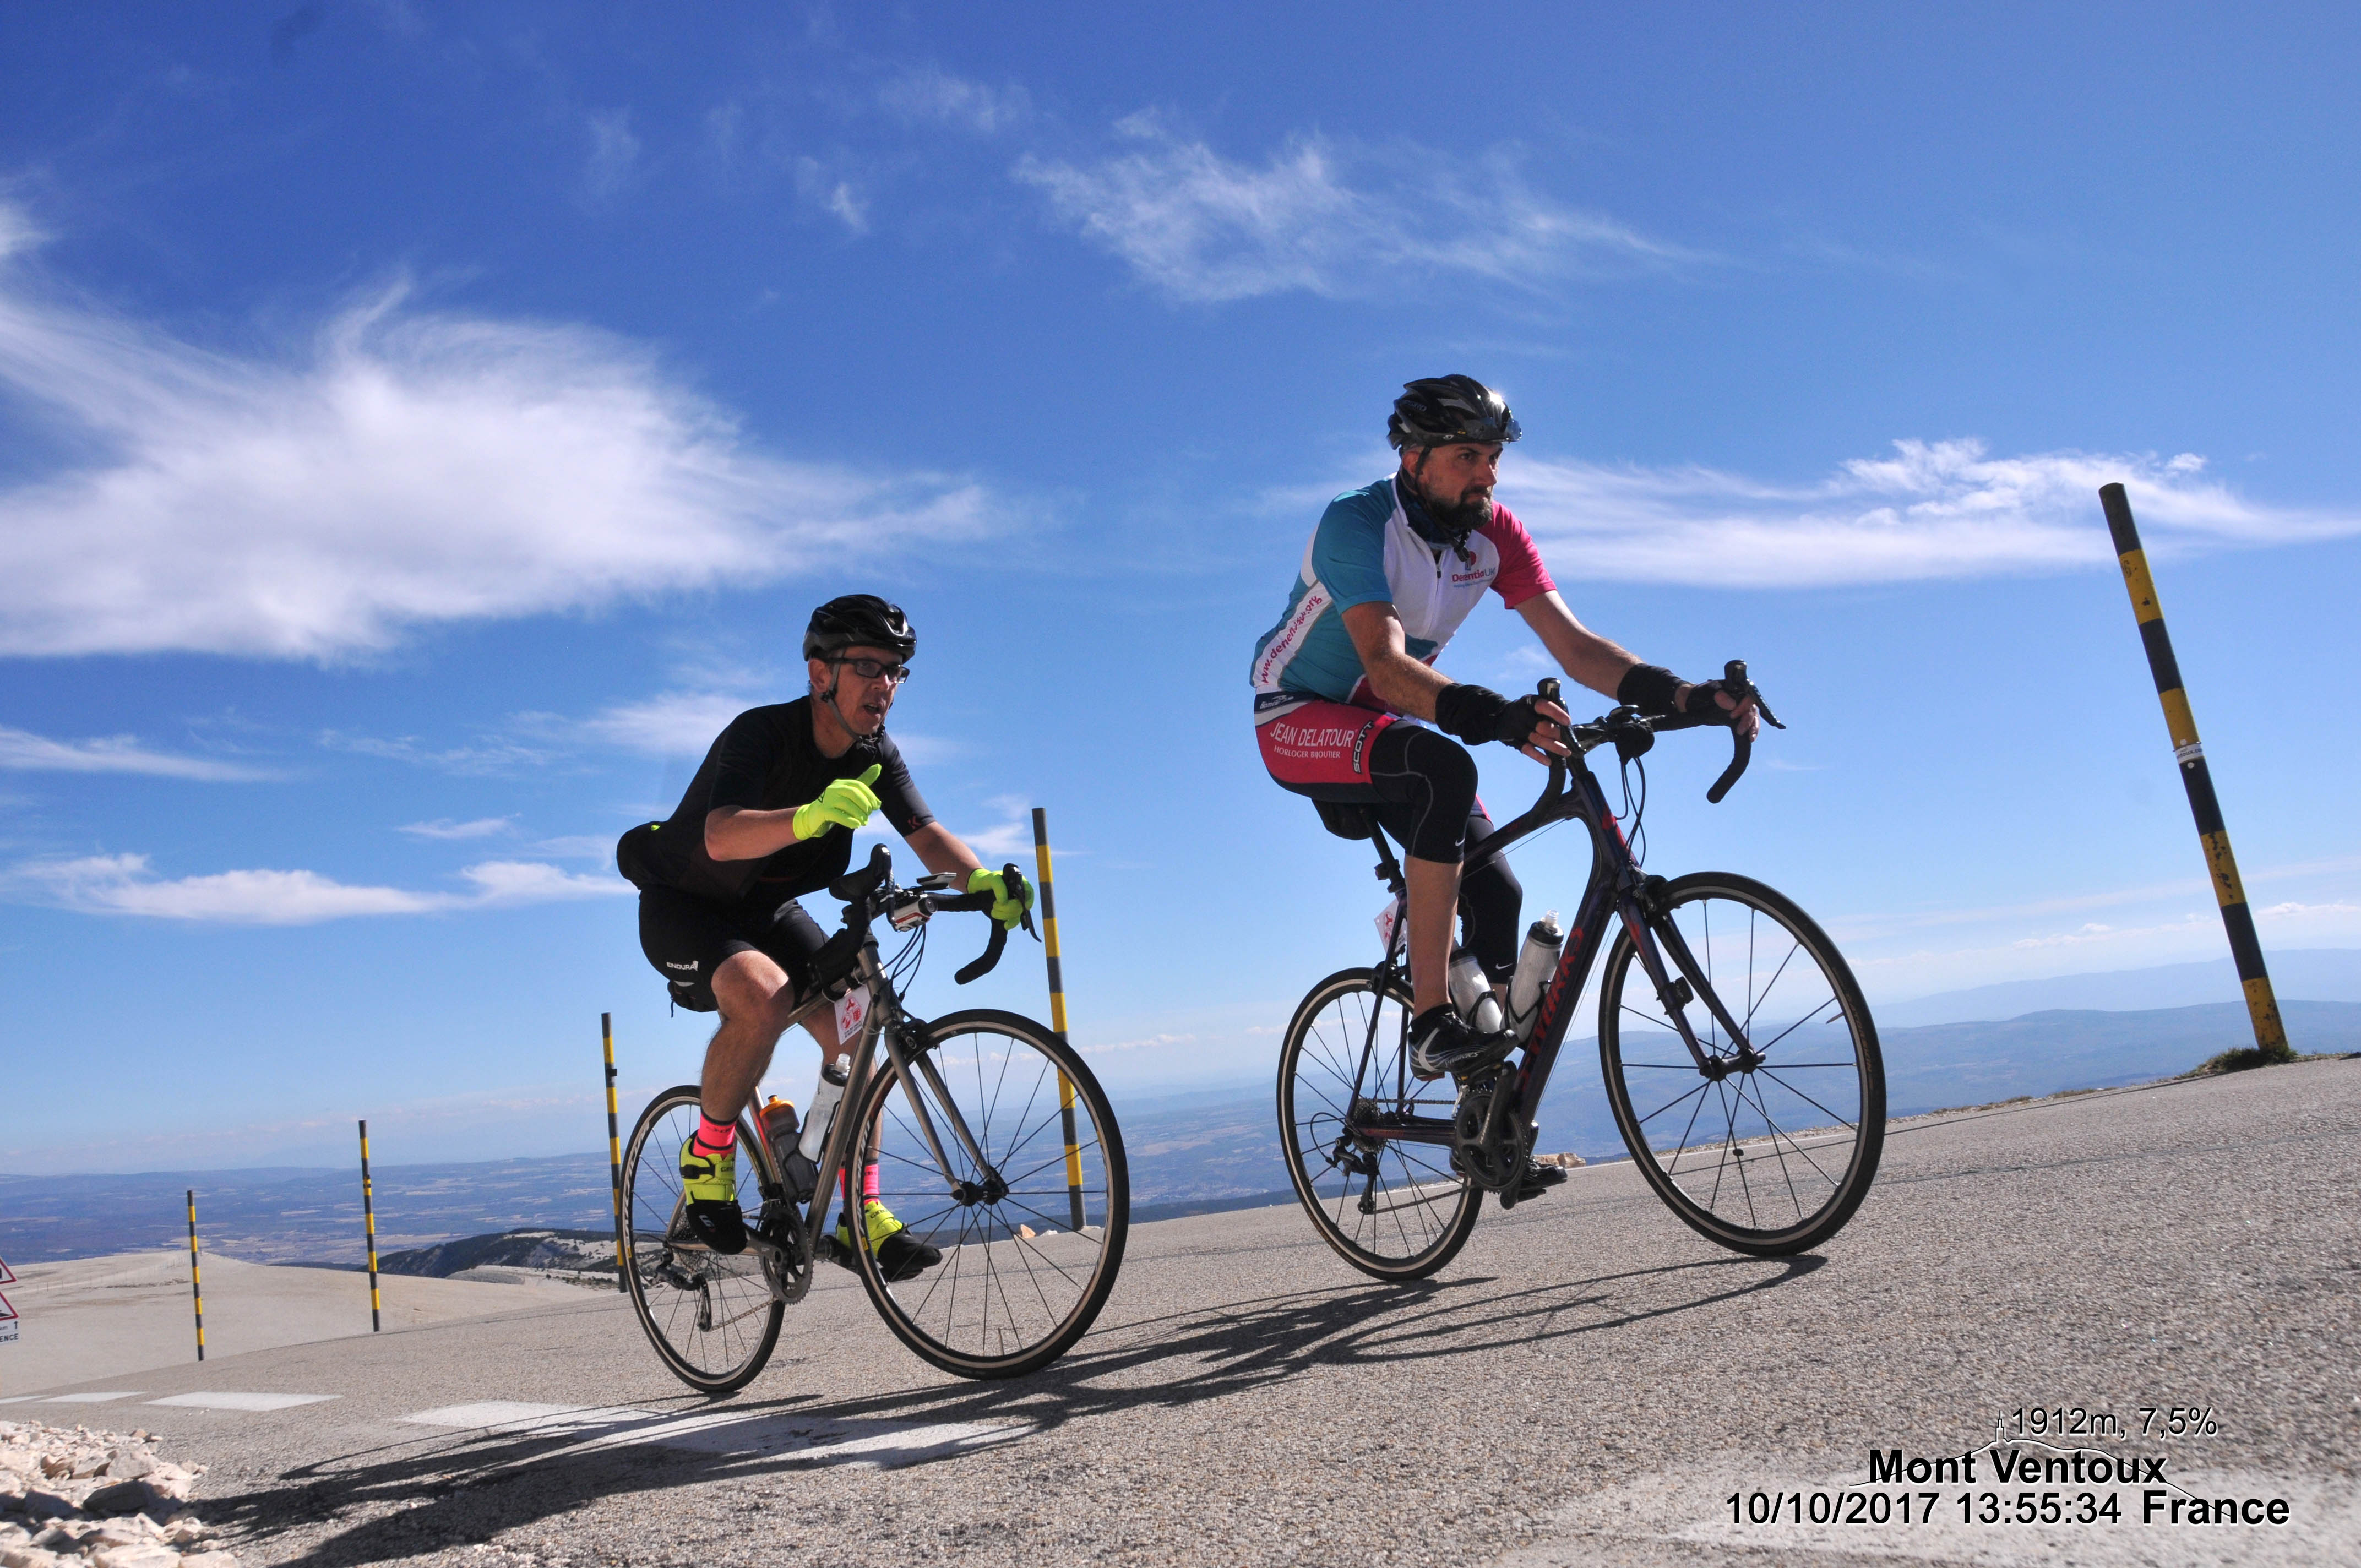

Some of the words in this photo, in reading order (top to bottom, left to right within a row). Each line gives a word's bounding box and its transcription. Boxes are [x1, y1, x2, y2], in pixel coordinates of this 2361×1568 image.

[1270, 722, 1298, 745] JEAN
[1297, 728, 1354, 748] DELATOUR
[1274, 745, 1308, 758] HORLOGER
[1311, 750, 1340, 759] BIJOUTIER
[1353, 721, 1372, 773] SCOTT
[666, 961, 695, 970] ENDURA
